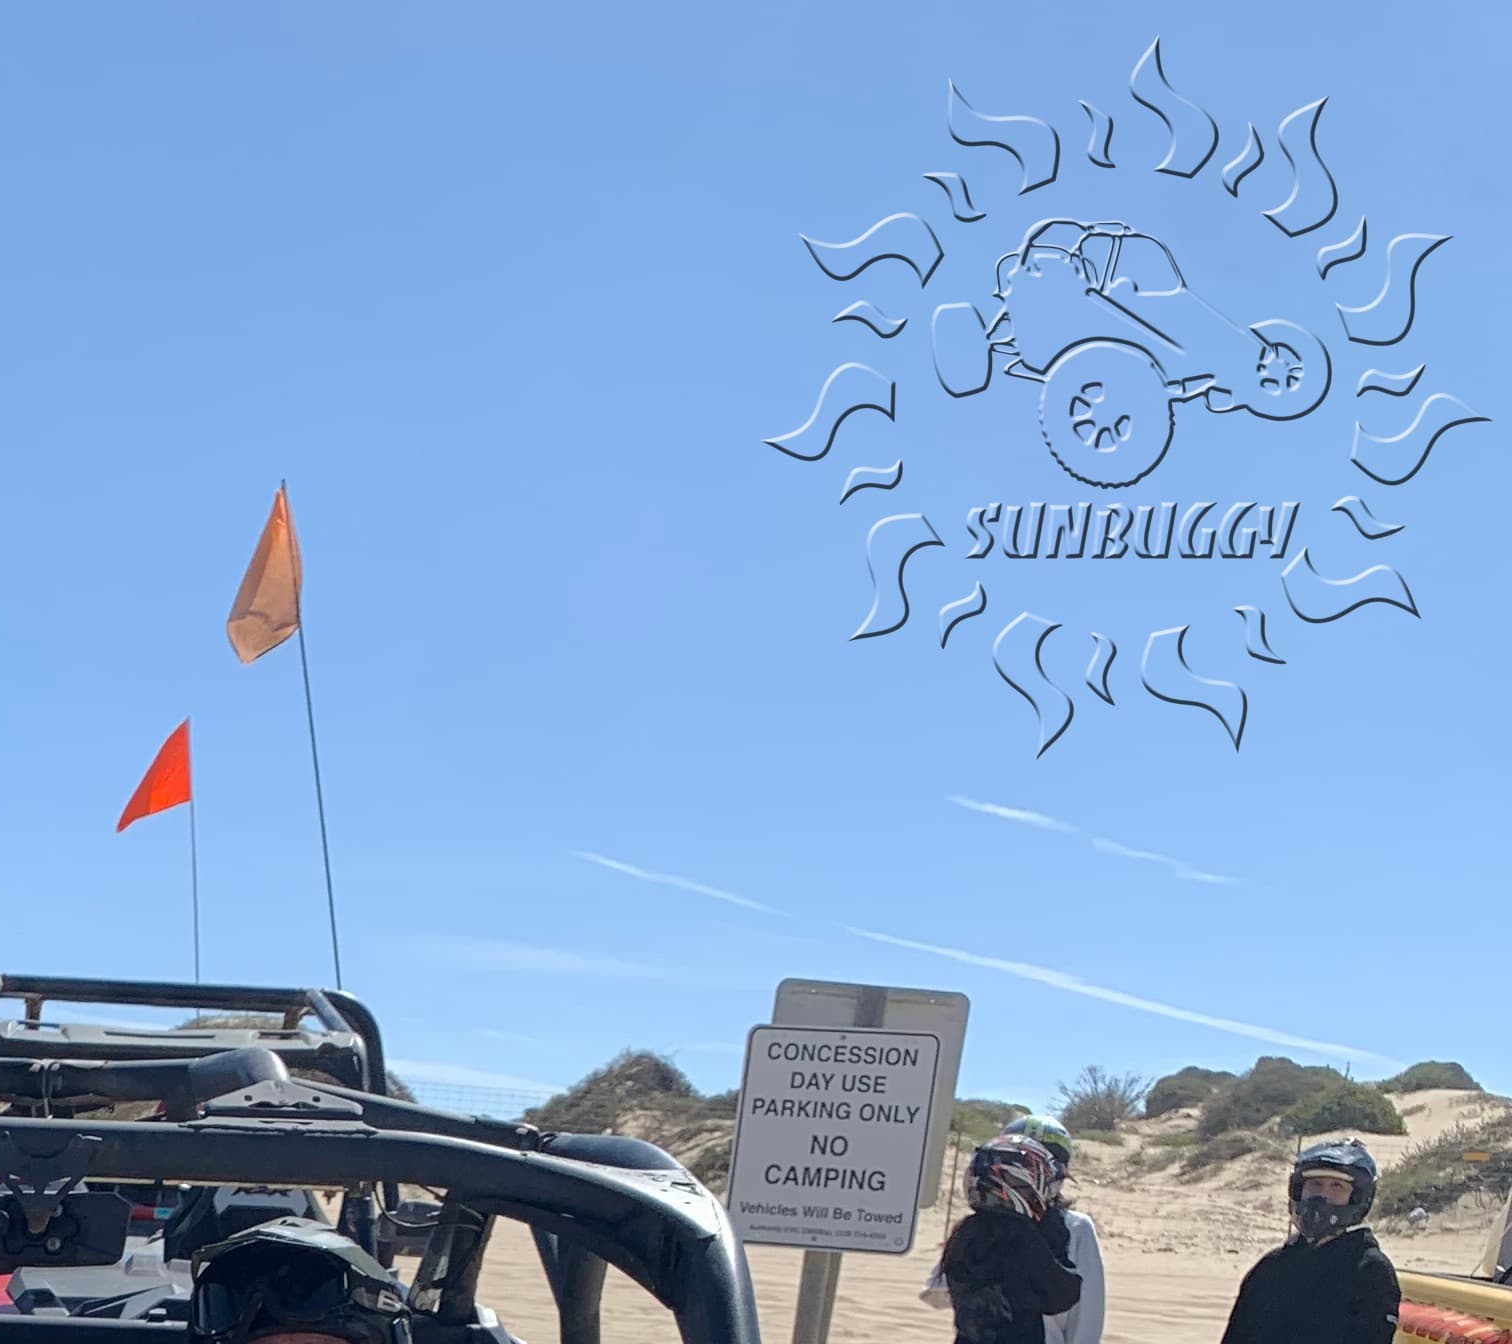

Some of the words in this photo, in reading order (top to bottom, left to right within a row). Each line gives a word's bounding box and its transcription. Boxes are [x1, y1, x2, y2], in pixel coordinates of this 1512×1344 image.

[767, 1042, 919, 1067] CONCESSION
[790, 1072, 835, 1092] DAY
[841, 1074, 887, 1094] USE
[751, 1098, 851, 1121] PARKING
[859, 1103, 920, 1124] ONLY
[809, 1135, 849, 1156] NO
[764, 1164, 886, 1191] CAMPING
[740, 1201, 798, 1217] Vehicles
[802, 1205, 828, 1219] Will
[832, 1207, 852, 1221] Be
[857, 1209, 903, 1224] Towed
